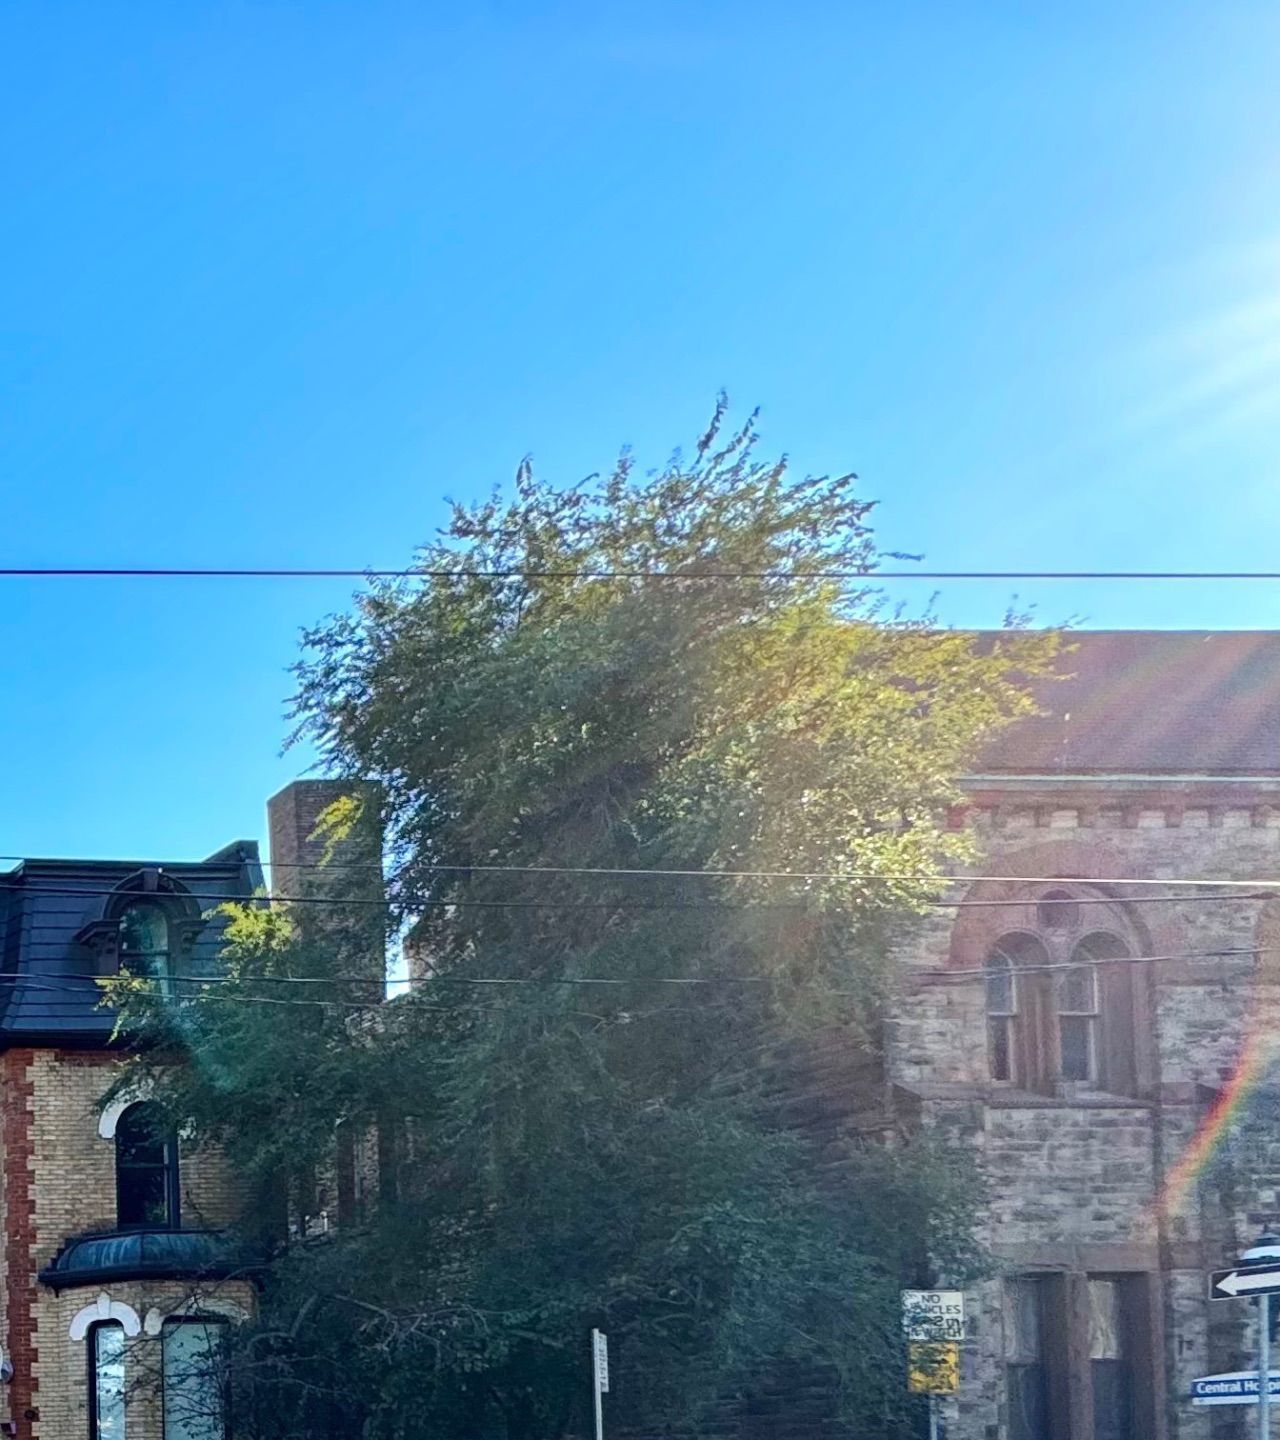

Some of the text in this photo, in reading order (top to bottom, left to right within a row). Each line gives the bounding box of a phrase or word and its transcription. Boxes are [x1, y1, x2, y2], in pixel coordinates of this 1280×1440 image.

[921, 1294, 941, 1304] NO
[910, 1305, 961, 1314] HICLES
[1196, 1382, 1242, 1394] Central
